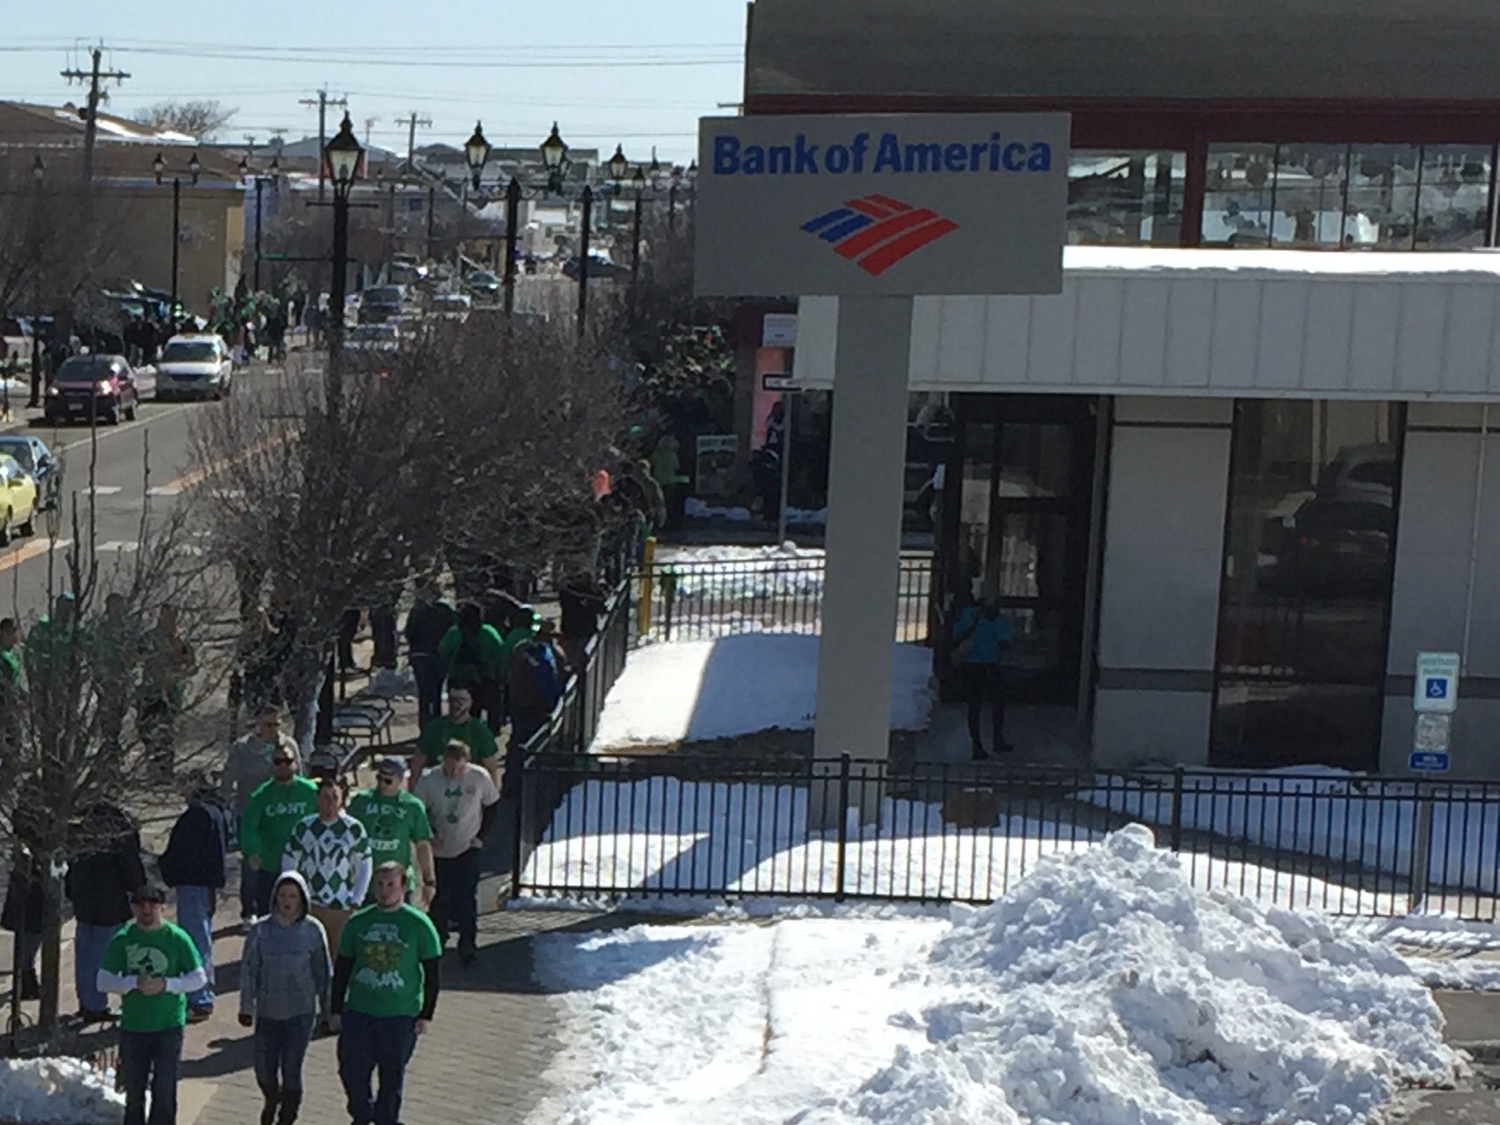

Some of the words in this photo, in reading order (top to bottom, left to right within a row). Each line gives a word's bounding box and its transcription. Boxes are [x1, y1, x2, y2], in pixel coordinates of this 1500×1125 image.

[712, 134, 819, 175] Bank
[824, 132, 869, 174] of
[873, 132, 1052, 173] America
